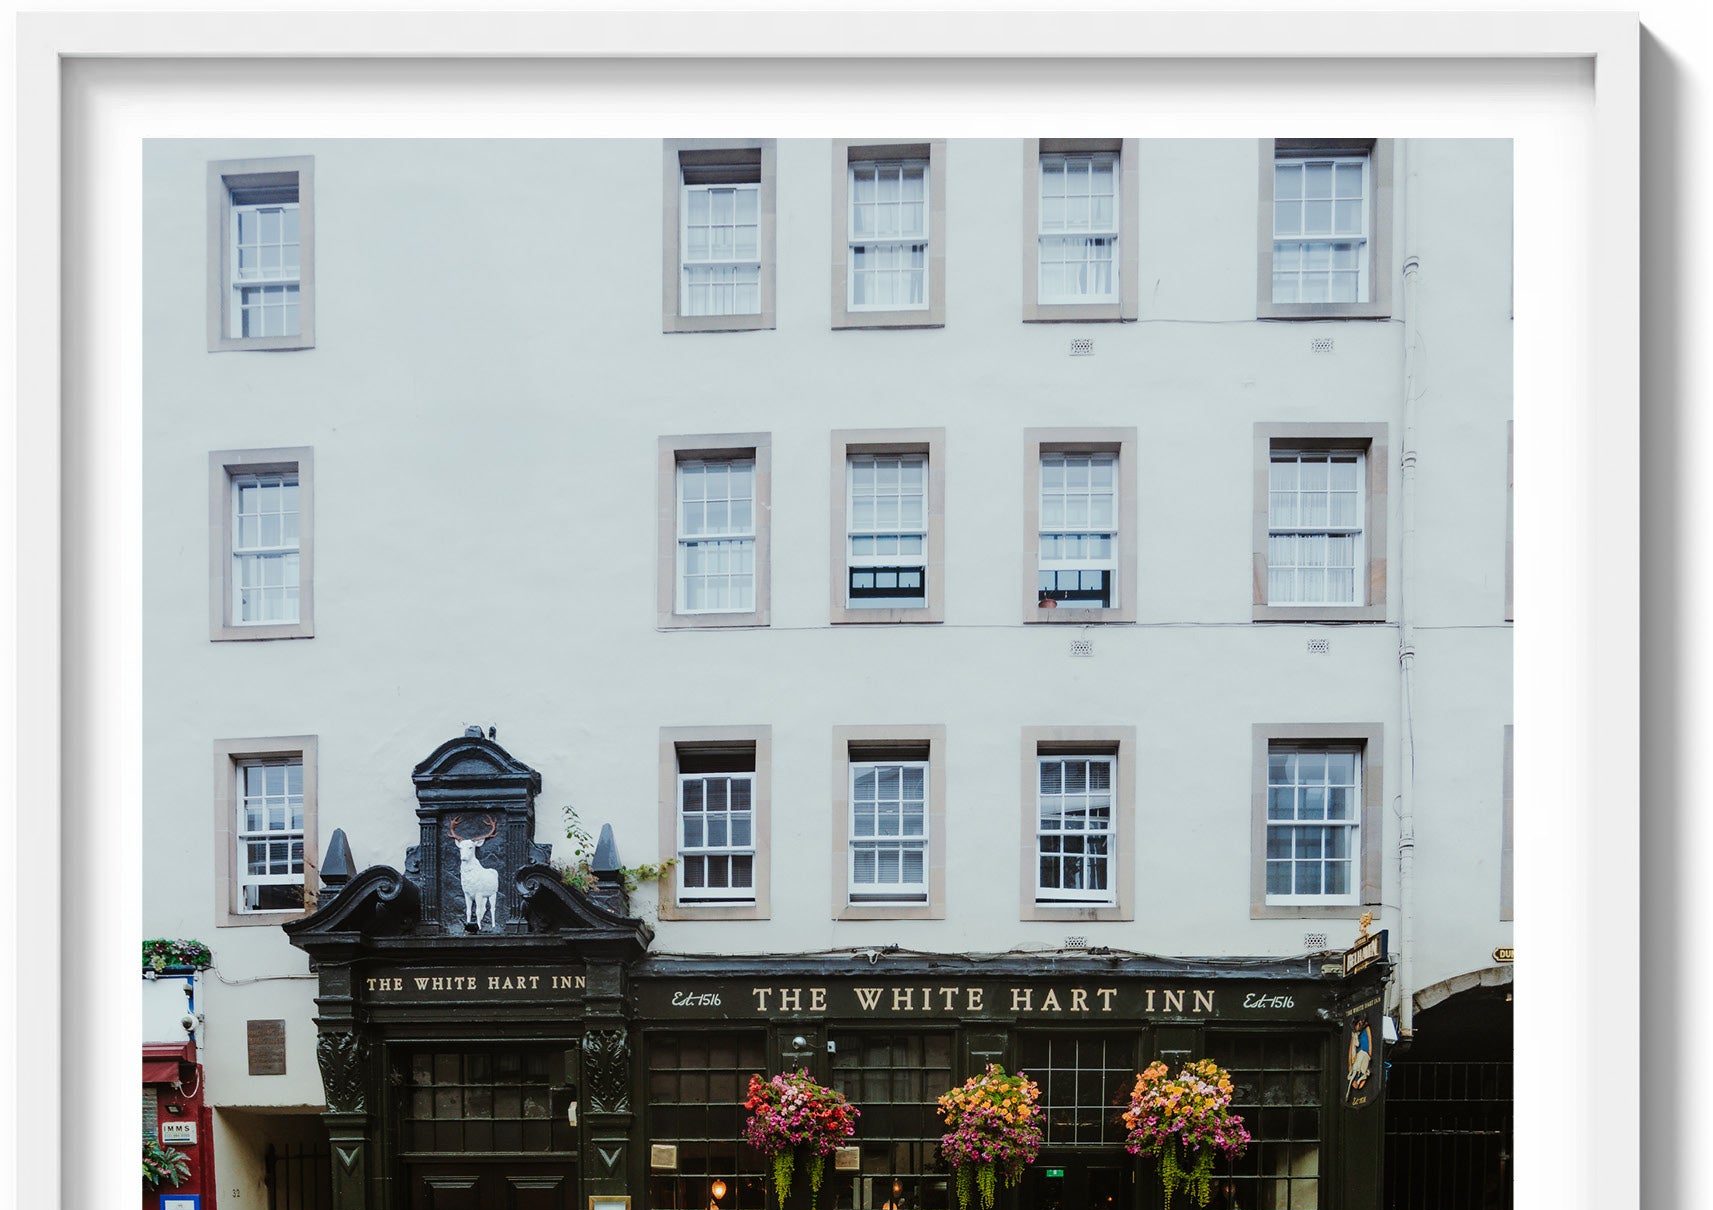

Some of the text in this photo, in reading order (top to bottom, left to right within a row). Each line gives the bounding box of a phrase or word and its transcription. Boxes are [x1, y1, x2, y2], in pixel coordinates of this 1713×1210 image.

[367, 976, 586, 991] THE WHITE HART INN
[697, 993, 721, 1006] 1516
[753, 987, 1215, 1012] THE WHITE HART INN
[1269, 995, 1294, 1008] 1516
